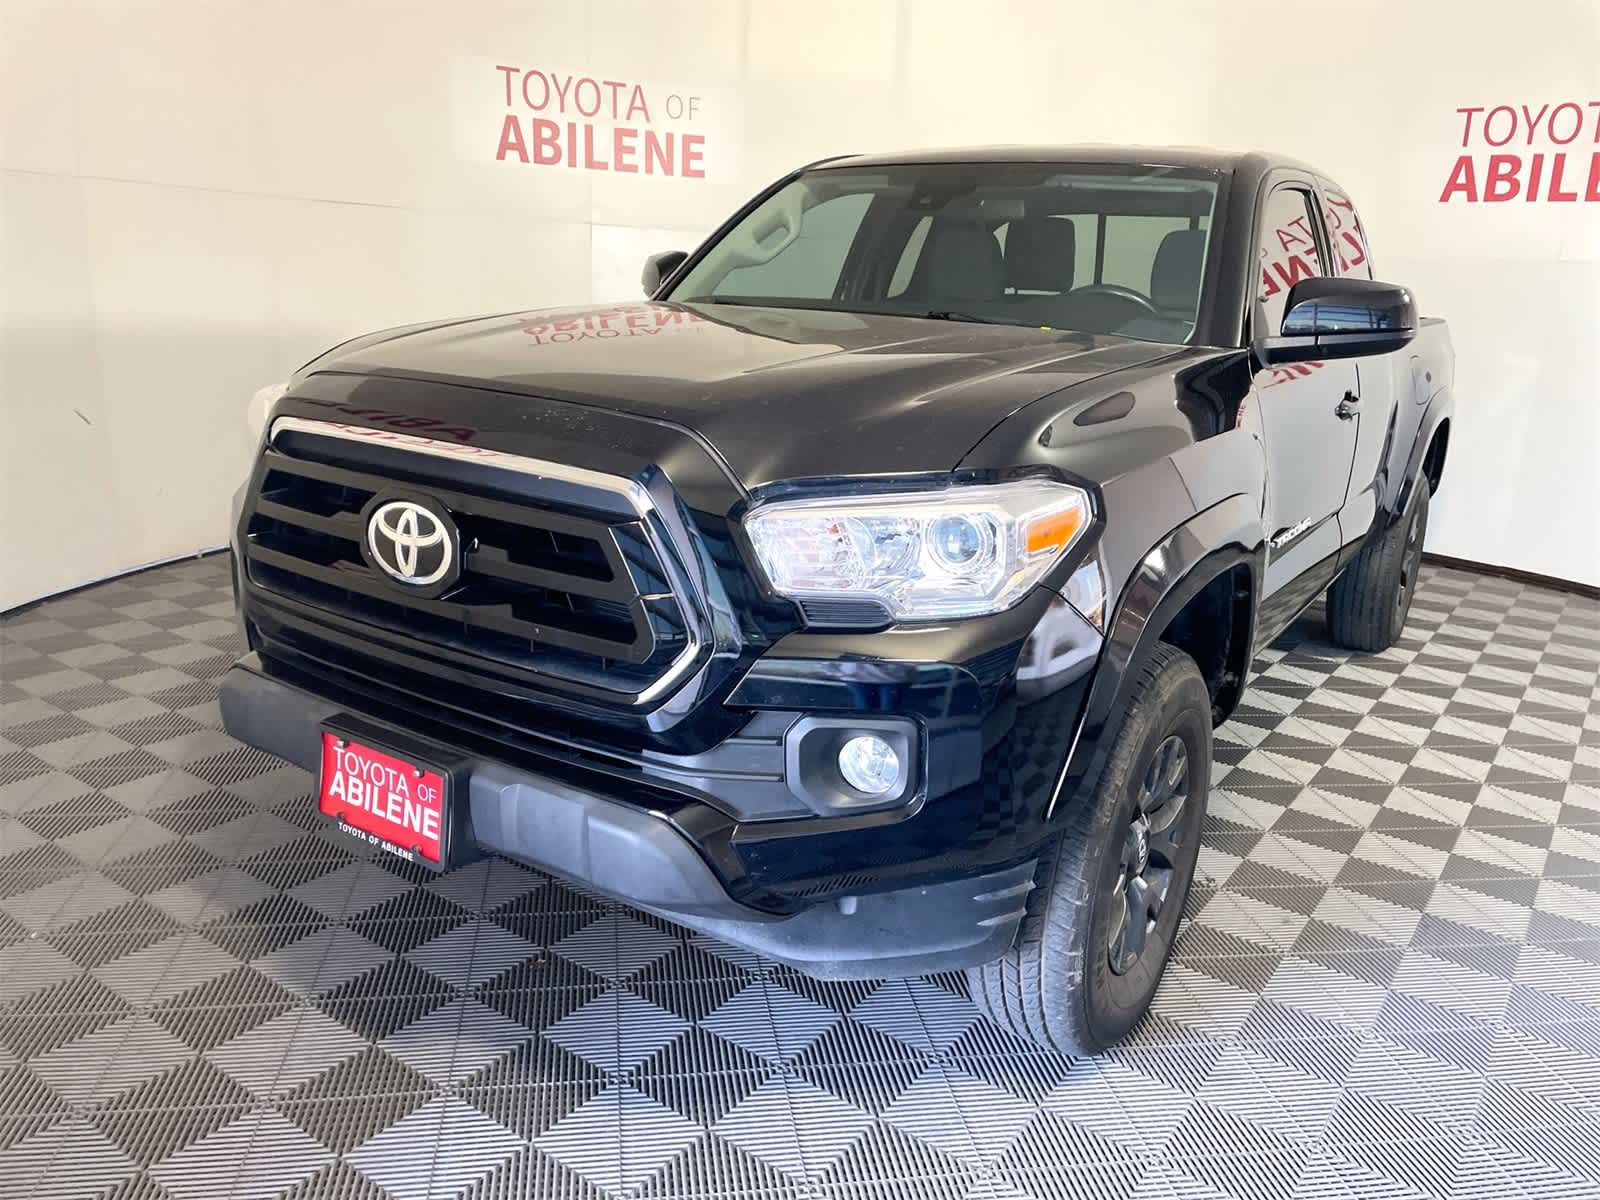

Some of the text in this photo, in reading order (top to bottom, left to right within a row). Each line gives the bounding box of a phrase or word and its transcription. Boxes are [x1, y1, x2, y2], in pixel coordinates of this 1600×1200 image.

[496, 65, 701, 122] TOYOTA OF
[496, 114, 705, 178] ABILENE
[333, 746, 437, 803] TOYOTA OF
[328, 770, 440, 841] ABILENE
[338, 822, 414, 862] TOYOTA OF ABILENE
